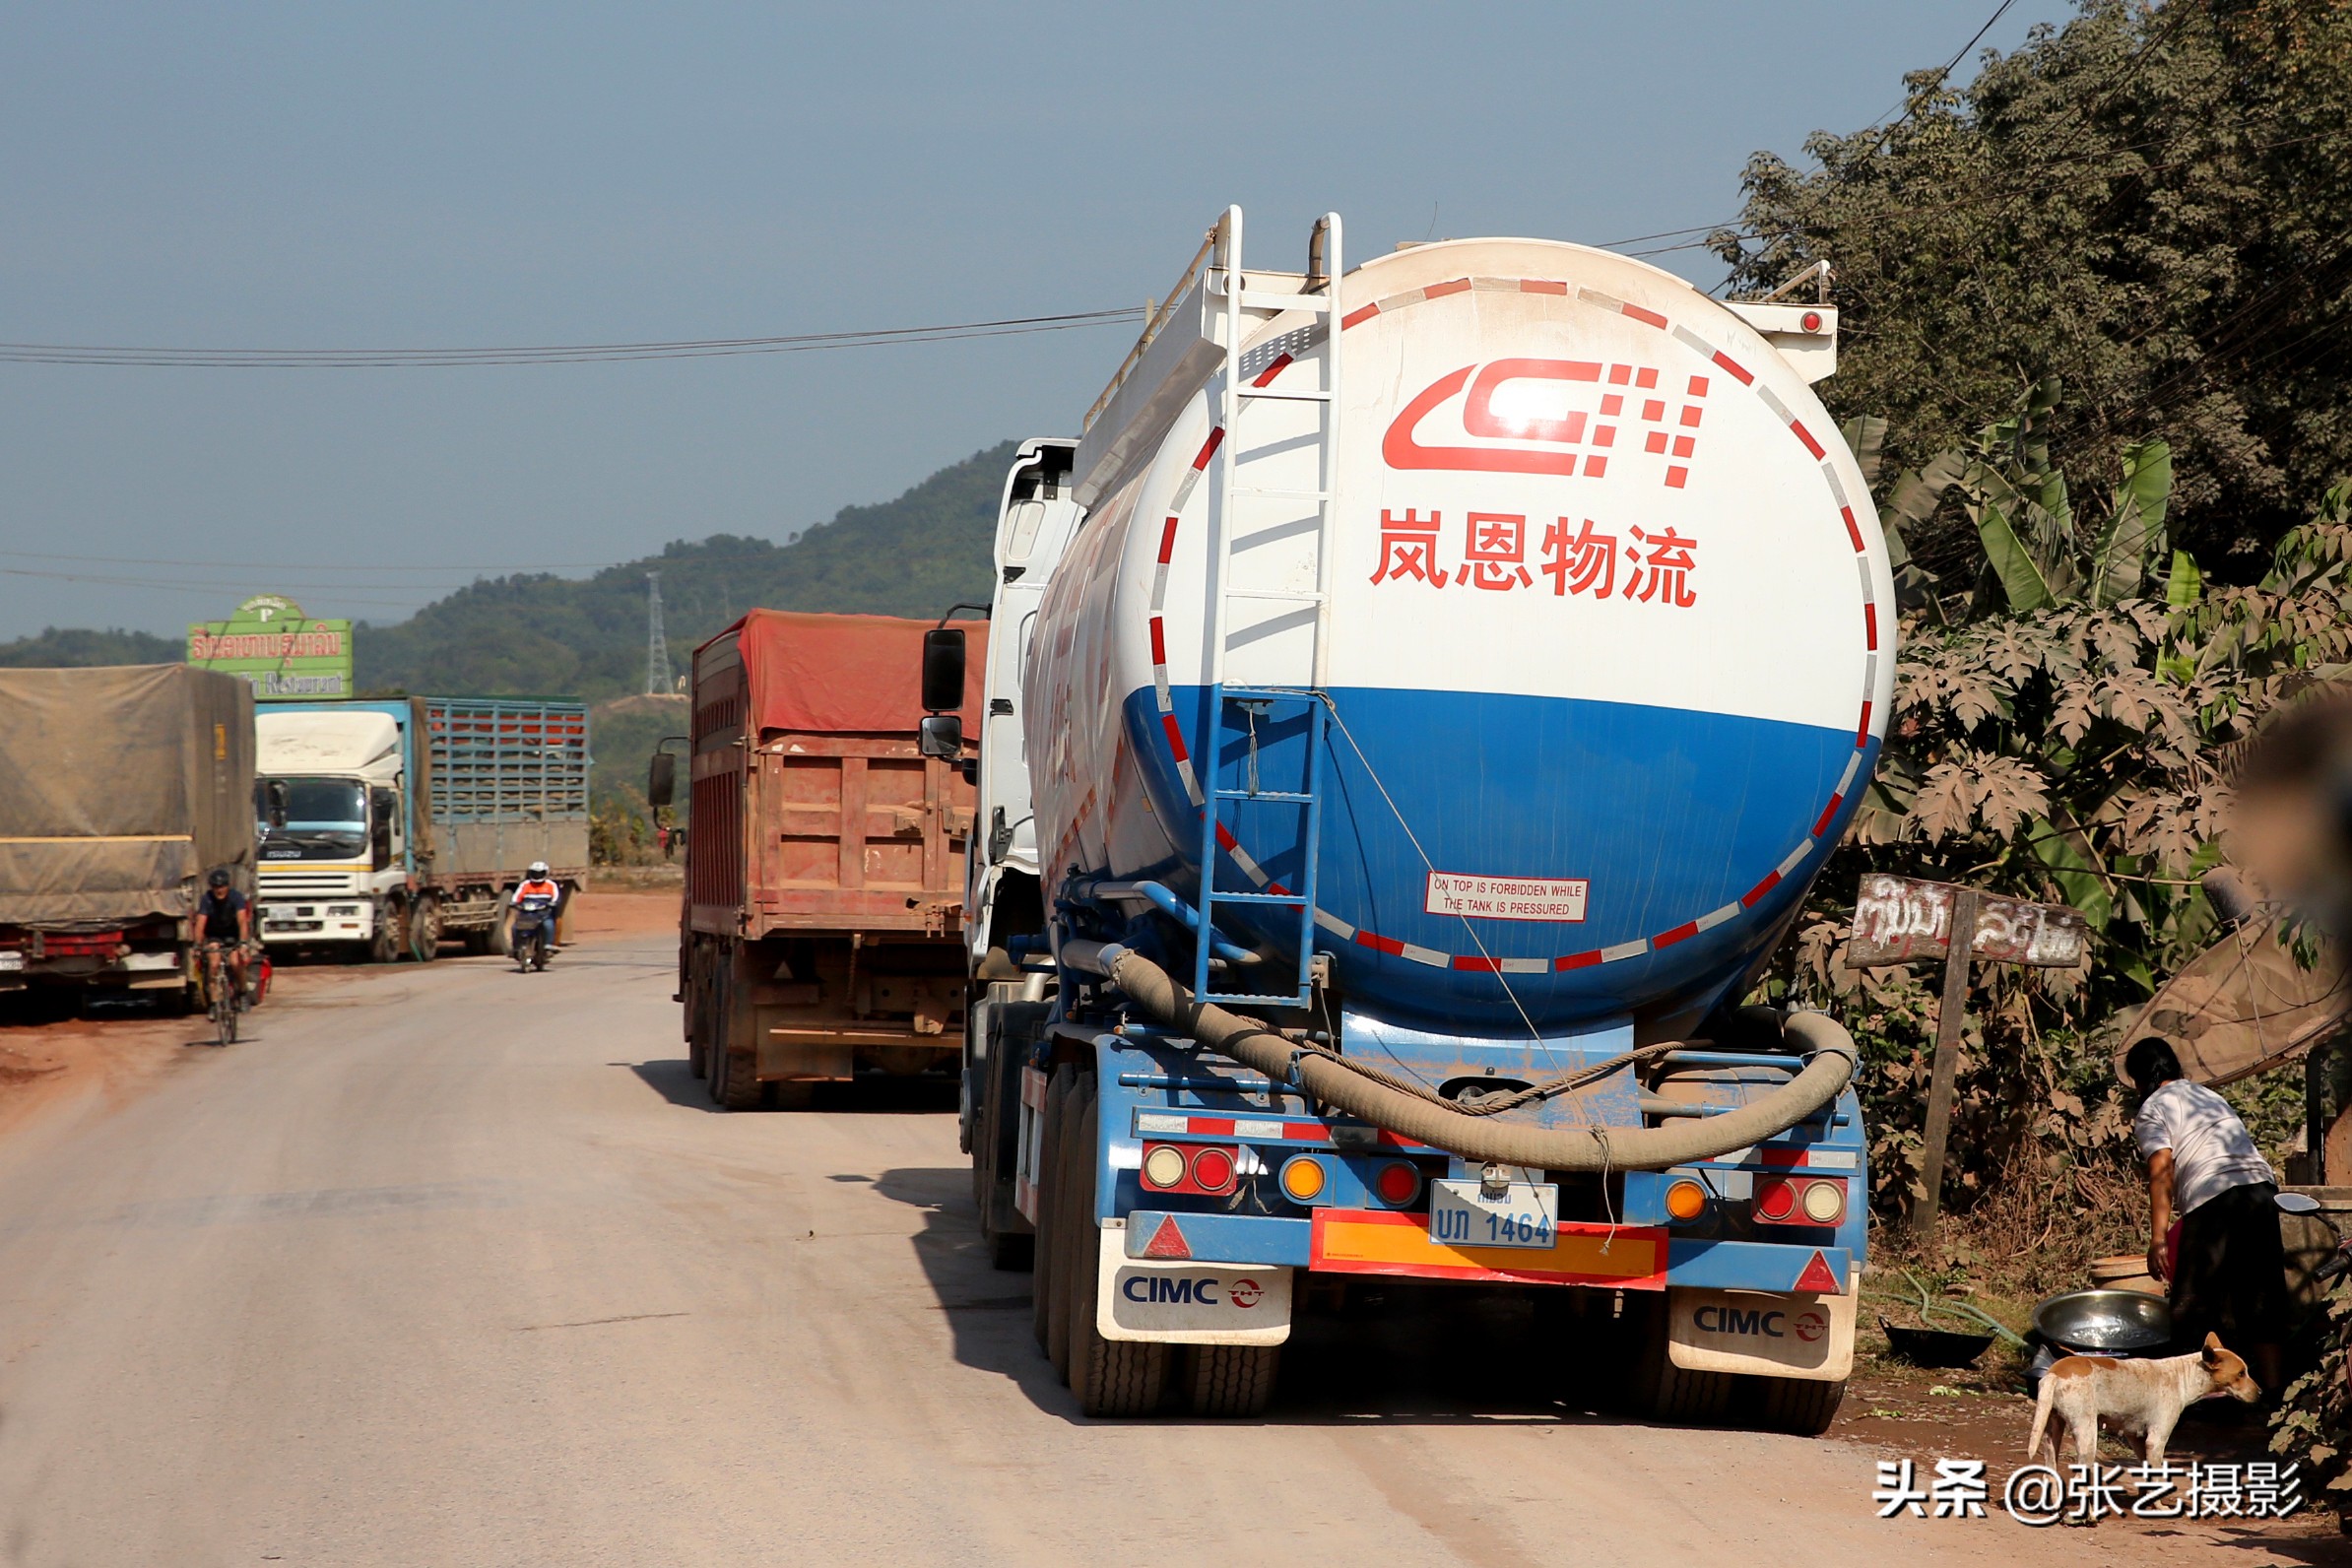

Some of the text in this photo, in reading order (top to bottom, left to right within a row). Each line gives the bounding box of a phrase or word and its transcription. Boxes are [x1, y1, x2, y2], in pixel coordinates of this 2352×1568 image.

[1369, 508, 1697, 608] 岚恩物流
[265, 672, 342, 694] Restaurant
[1434, 879, 1582, 897] ON TOP IS FORBIDDEN WHILE
[1444, 897, 1569, 915] THE TANK IS PRESSURED
[1485, 1212, 1550, 1244] 1464
[1123, 1275, 1218, 1305] CIMC
[1693, 1306, 1785, 1338] CIMC
